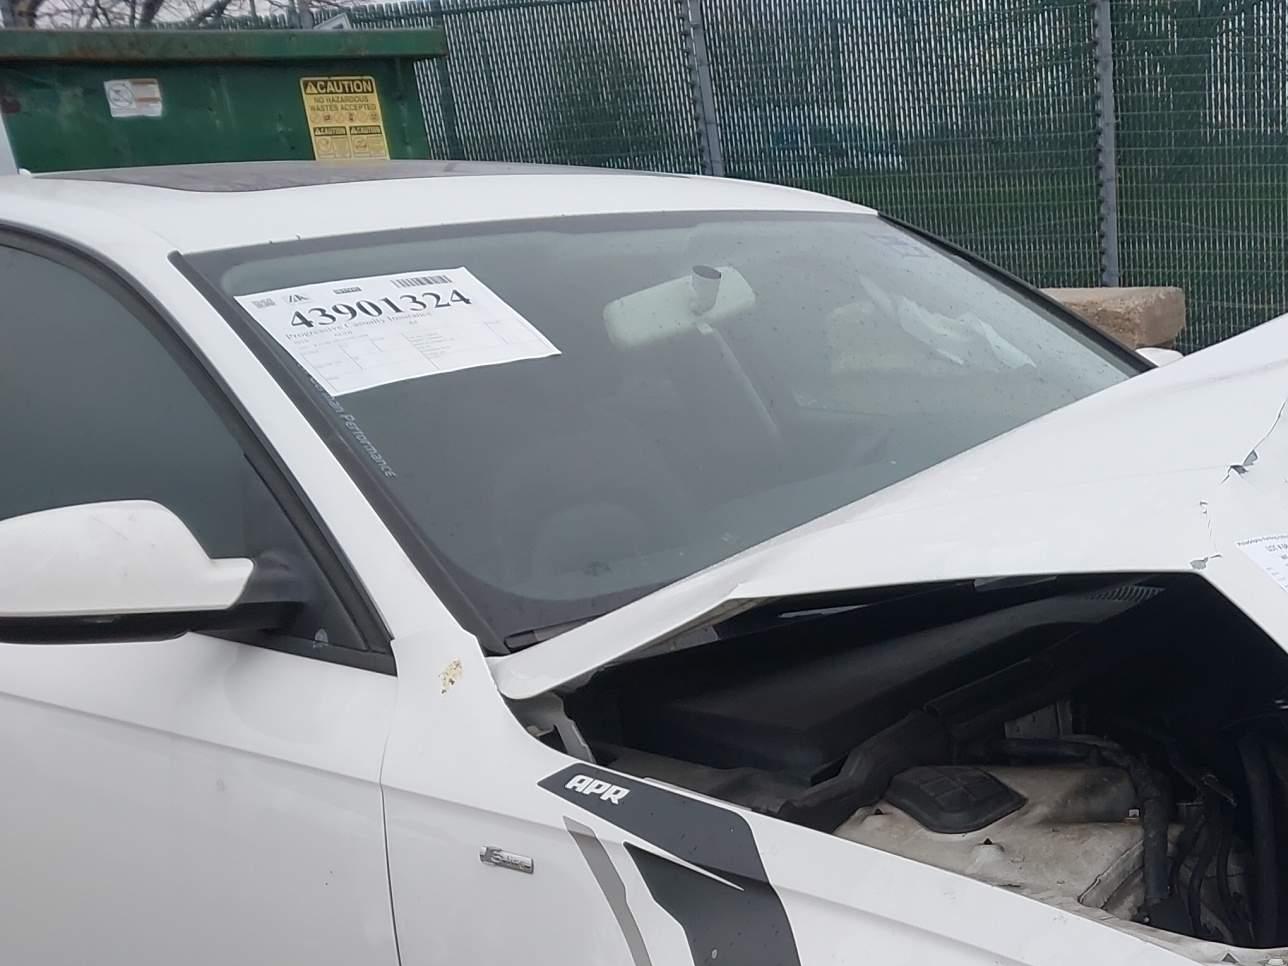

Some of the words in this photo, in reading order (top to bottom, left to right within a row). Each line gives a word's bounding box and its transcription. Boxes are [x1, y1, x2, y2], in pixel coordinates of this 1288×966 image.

[316, 80, 373, 93] CAUTION
[313, 96, 325, 104] NO
[326, 95, 369, 103] HAZARDOUS
[310, 104, 339, 112] WASTES
[340, 103, 377, 111] ACCEPTED
[290, 289, 473, 328] 43901324
[565, 774, 631, 805] APR
